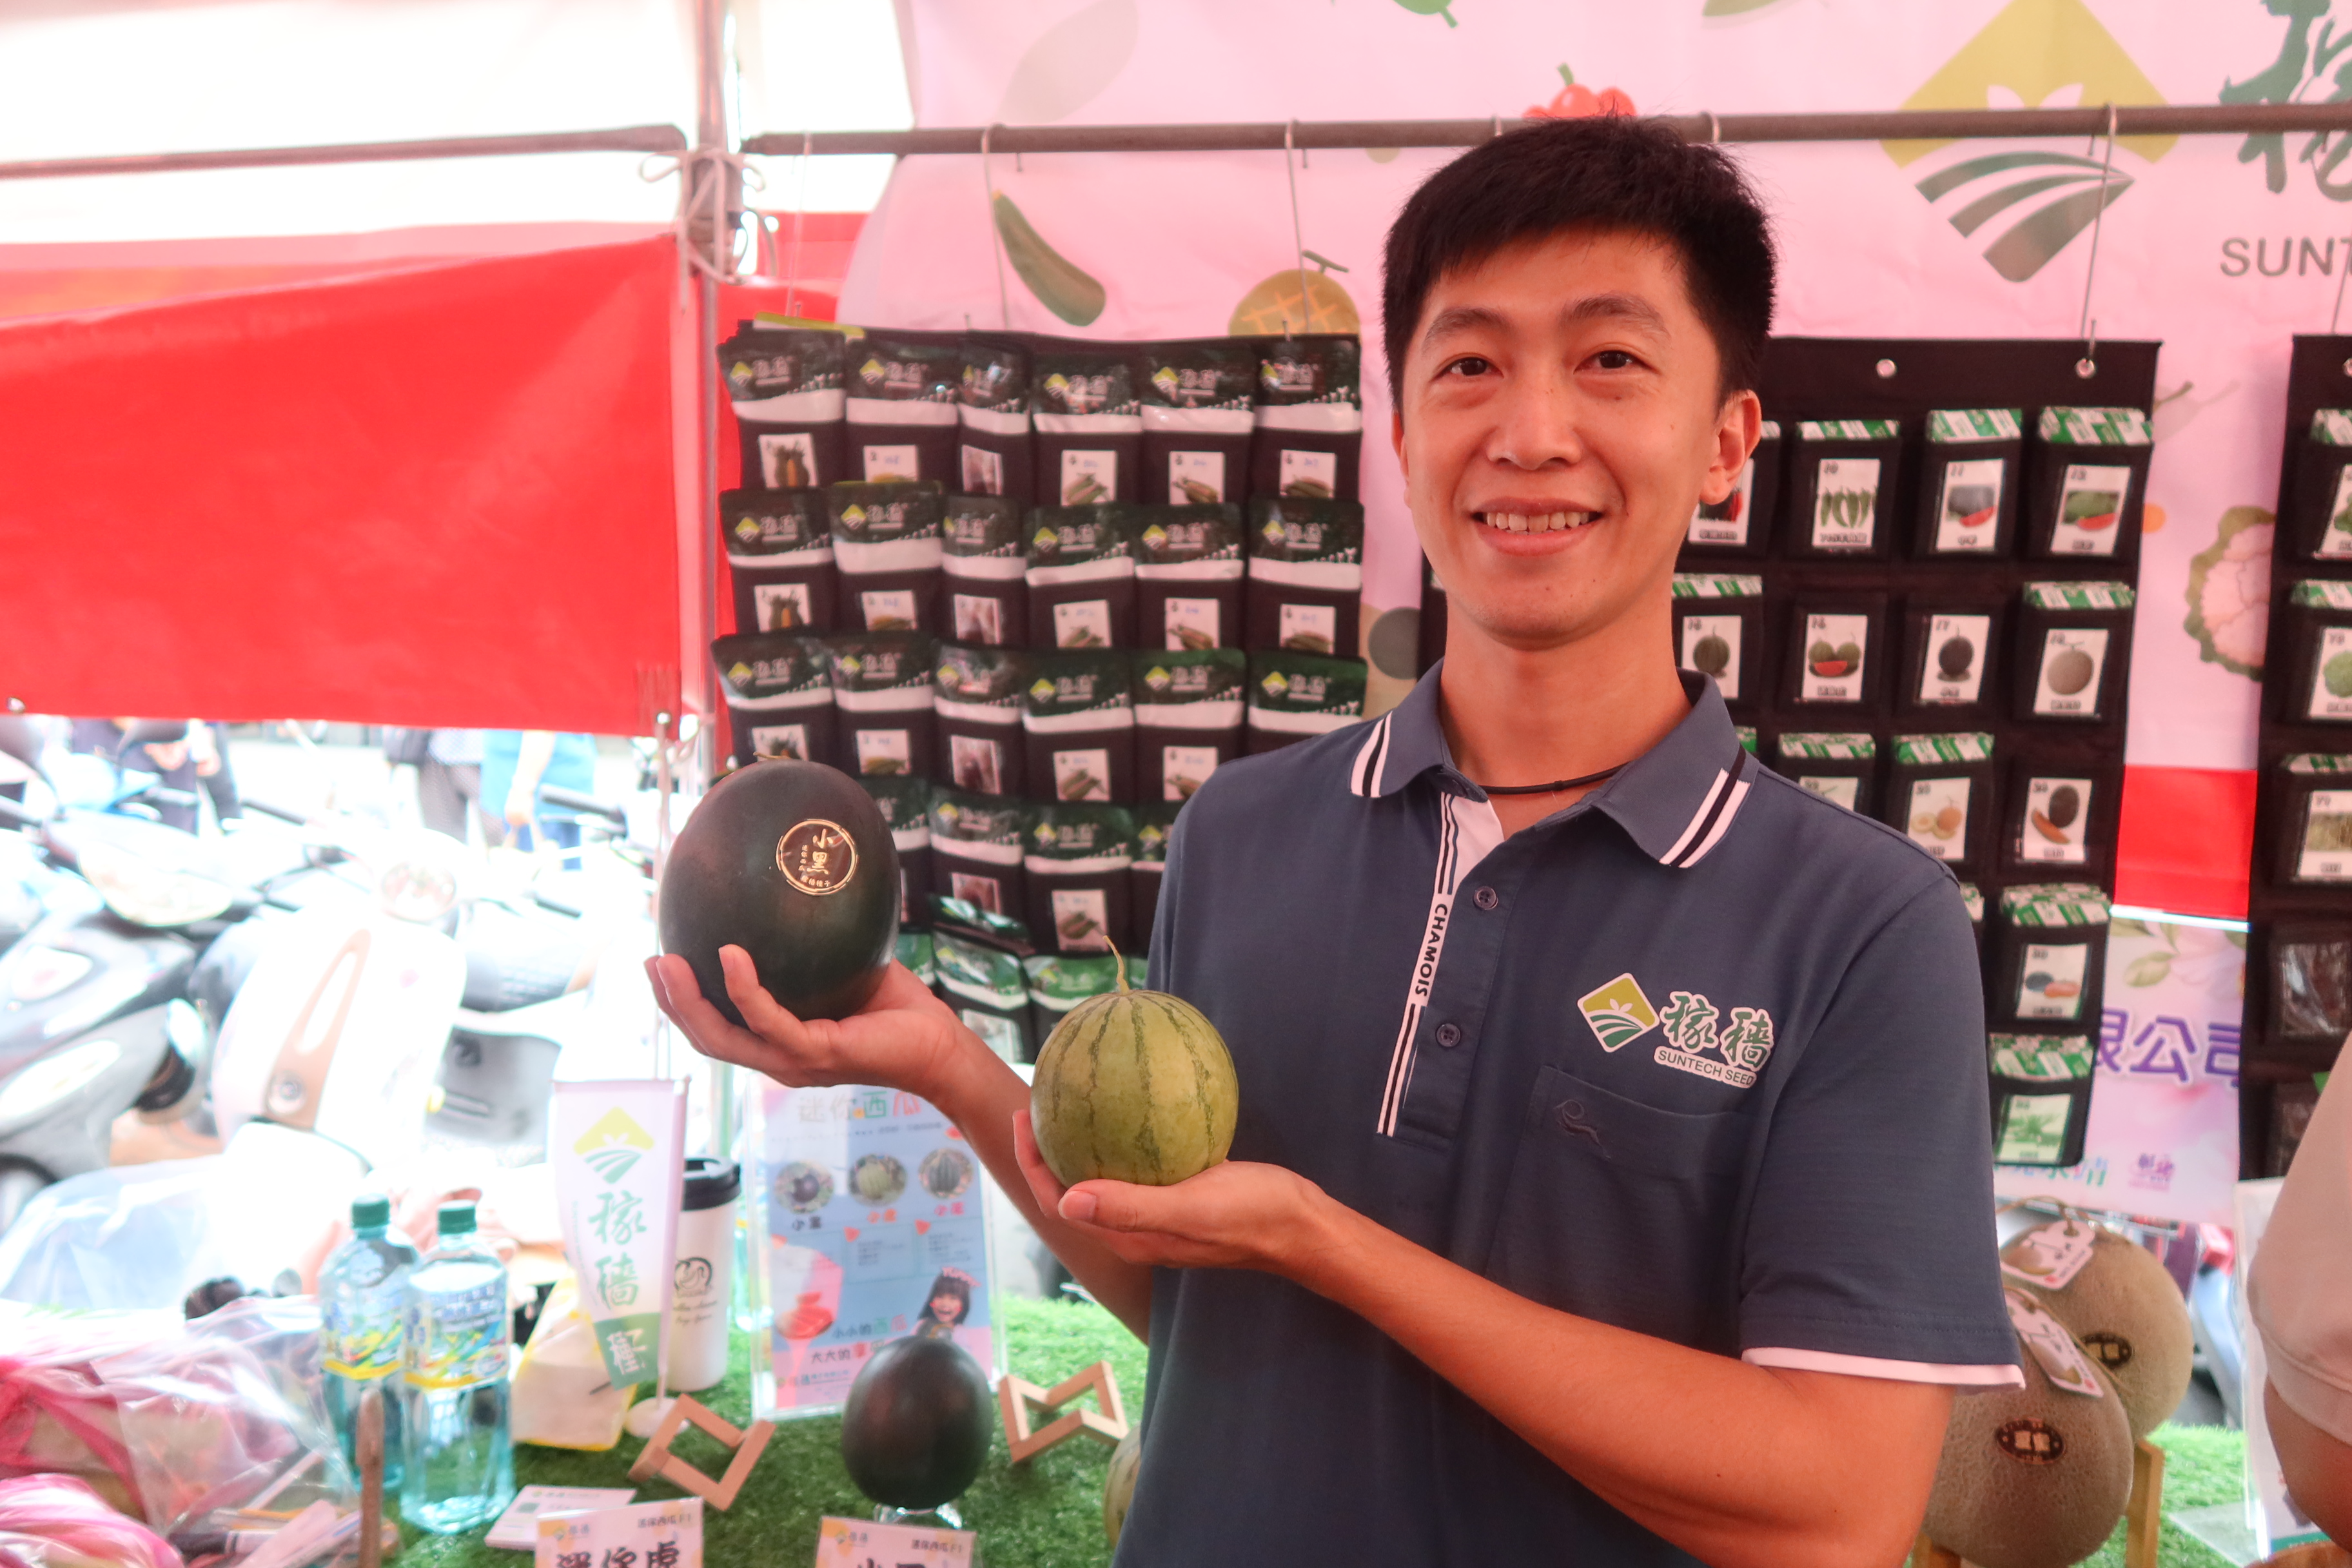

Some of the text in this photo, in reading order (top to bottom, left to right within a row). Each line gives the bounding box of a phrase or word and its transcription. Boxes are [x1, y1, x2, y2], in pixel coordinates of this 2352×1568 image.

[1415, 903, 1448, 997] CHAMOIS
[1657, 1048, 1755, 1087] SUNTECH SEED
